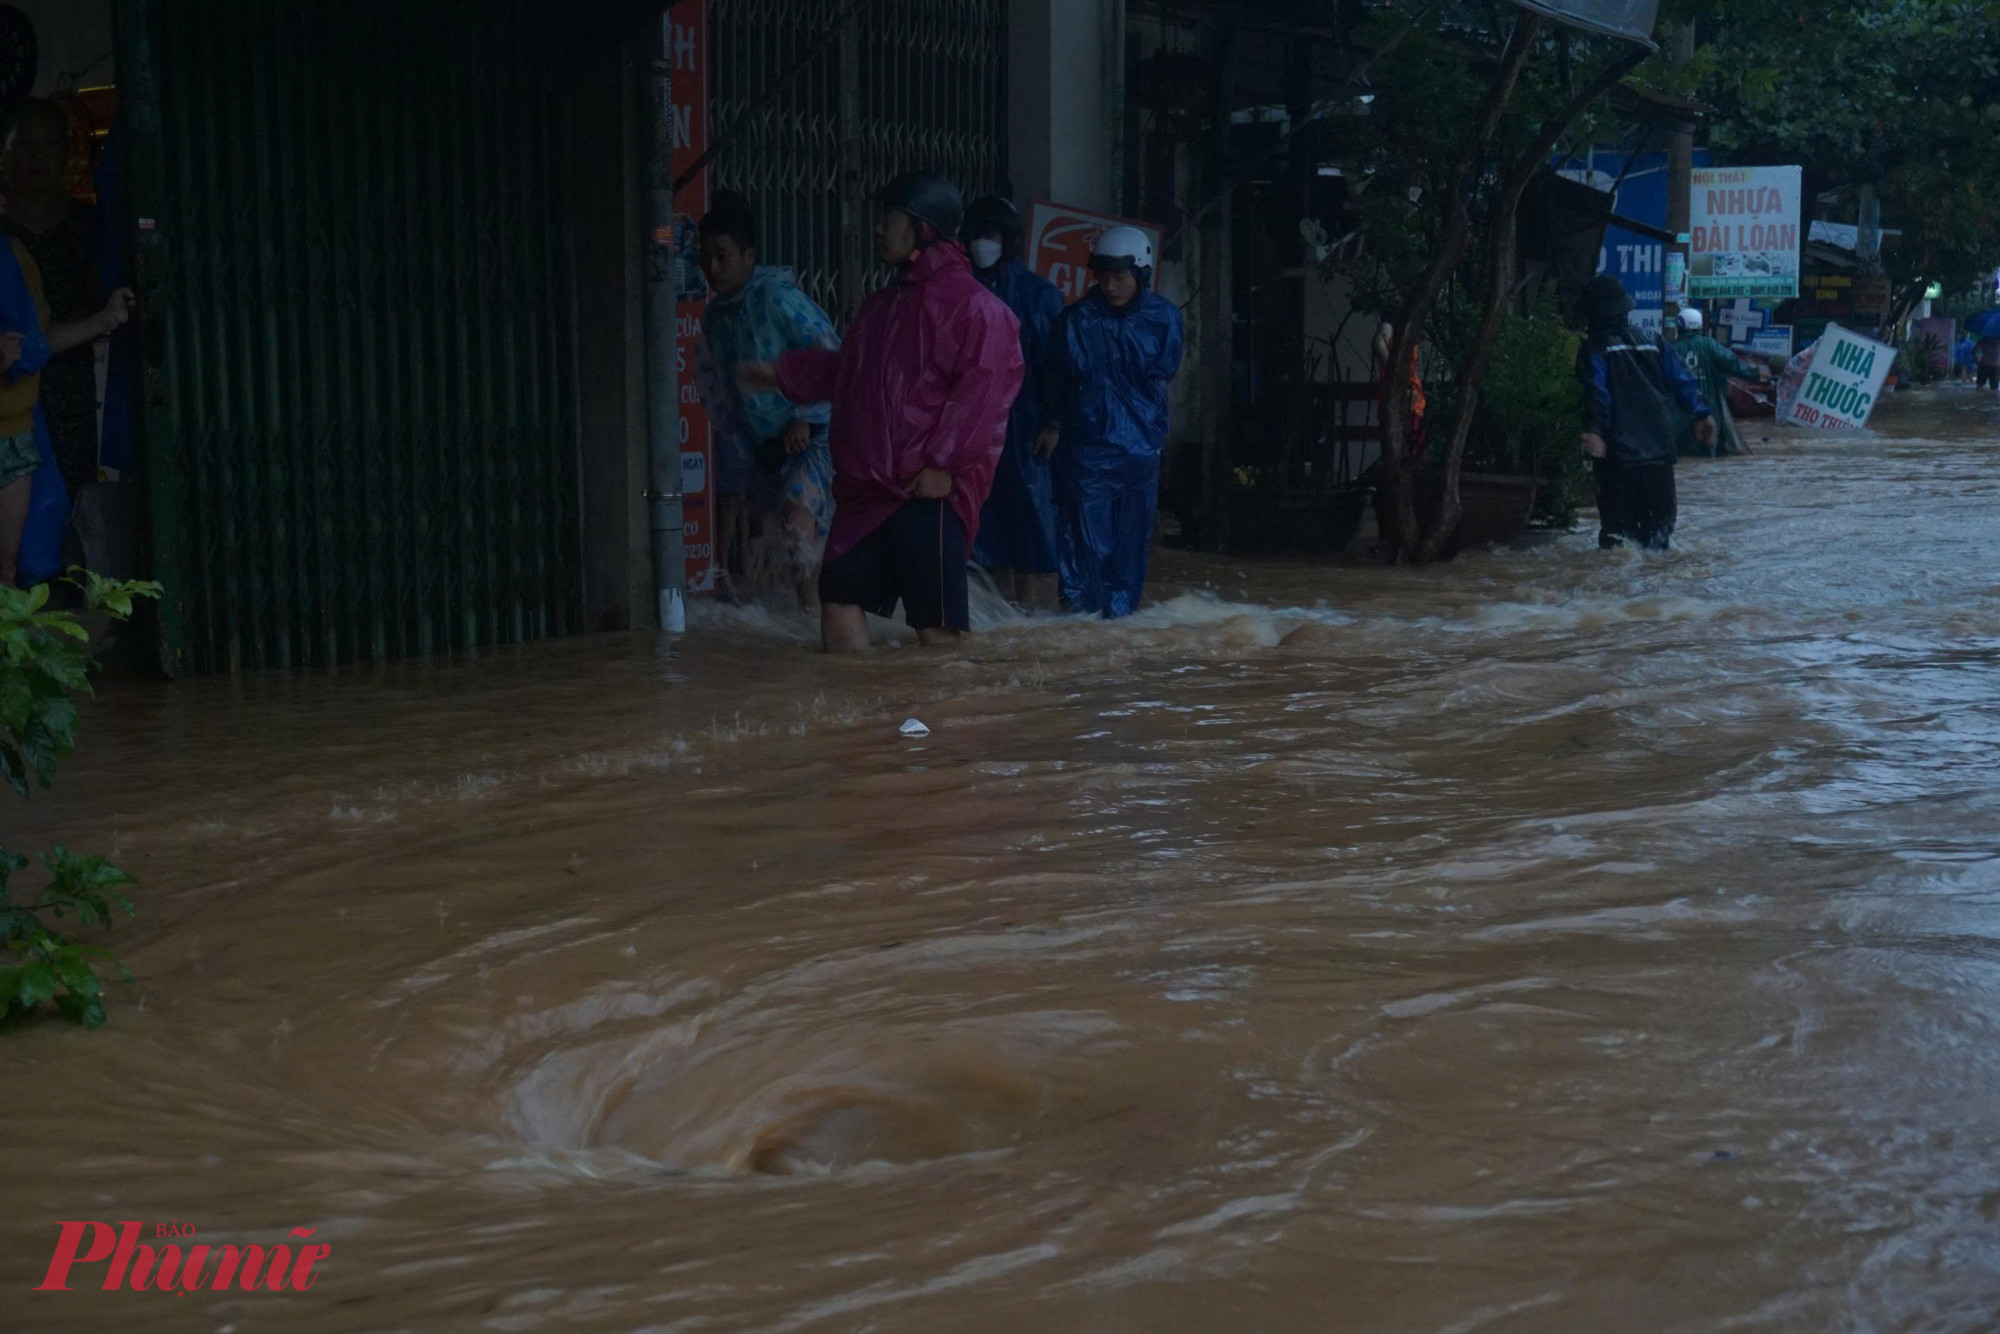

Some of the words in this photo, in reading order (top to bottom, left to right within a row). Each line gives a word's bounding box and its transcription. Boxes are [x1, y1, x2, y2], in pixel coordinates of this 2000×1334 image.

[1707, 187, 1783, 219] NHỰA
[1692, 220, 1730, 252] ĐÀI
[1738, 224, 1796, 252] LOAN
[1829, 339, 1876, 379] NHÀ
[1804, 371, 1872, 419] THUỐC
